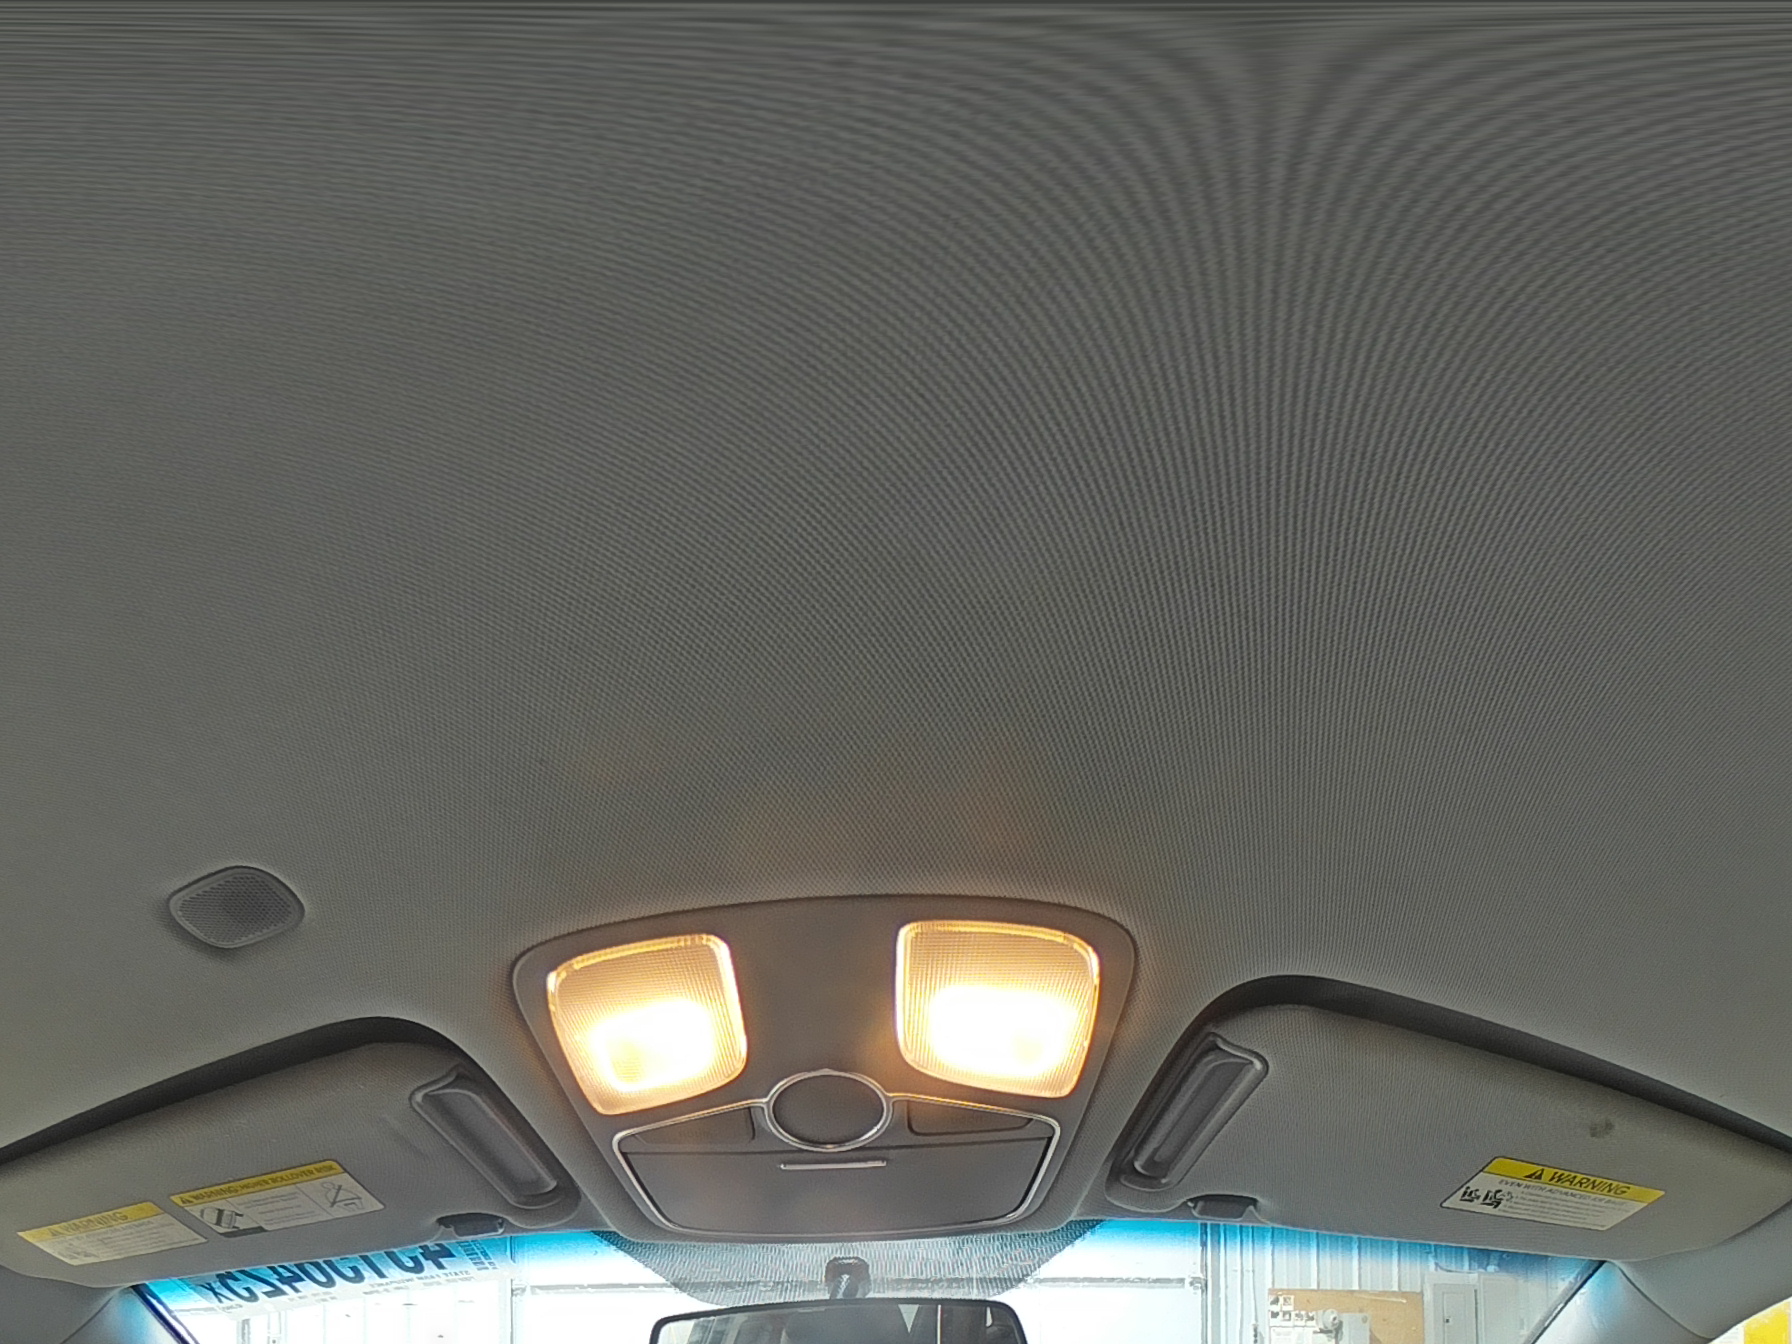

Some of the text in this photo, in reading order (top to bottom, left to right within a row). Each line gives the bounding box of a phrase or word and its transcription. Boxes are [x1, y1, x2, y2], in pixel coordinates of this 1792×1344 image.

[1498, 1179, 1524, 1188] EVEN
[1548, 1171, 1631, 1196] WARNING
[62, 1211, 129, 1236] WARNING
